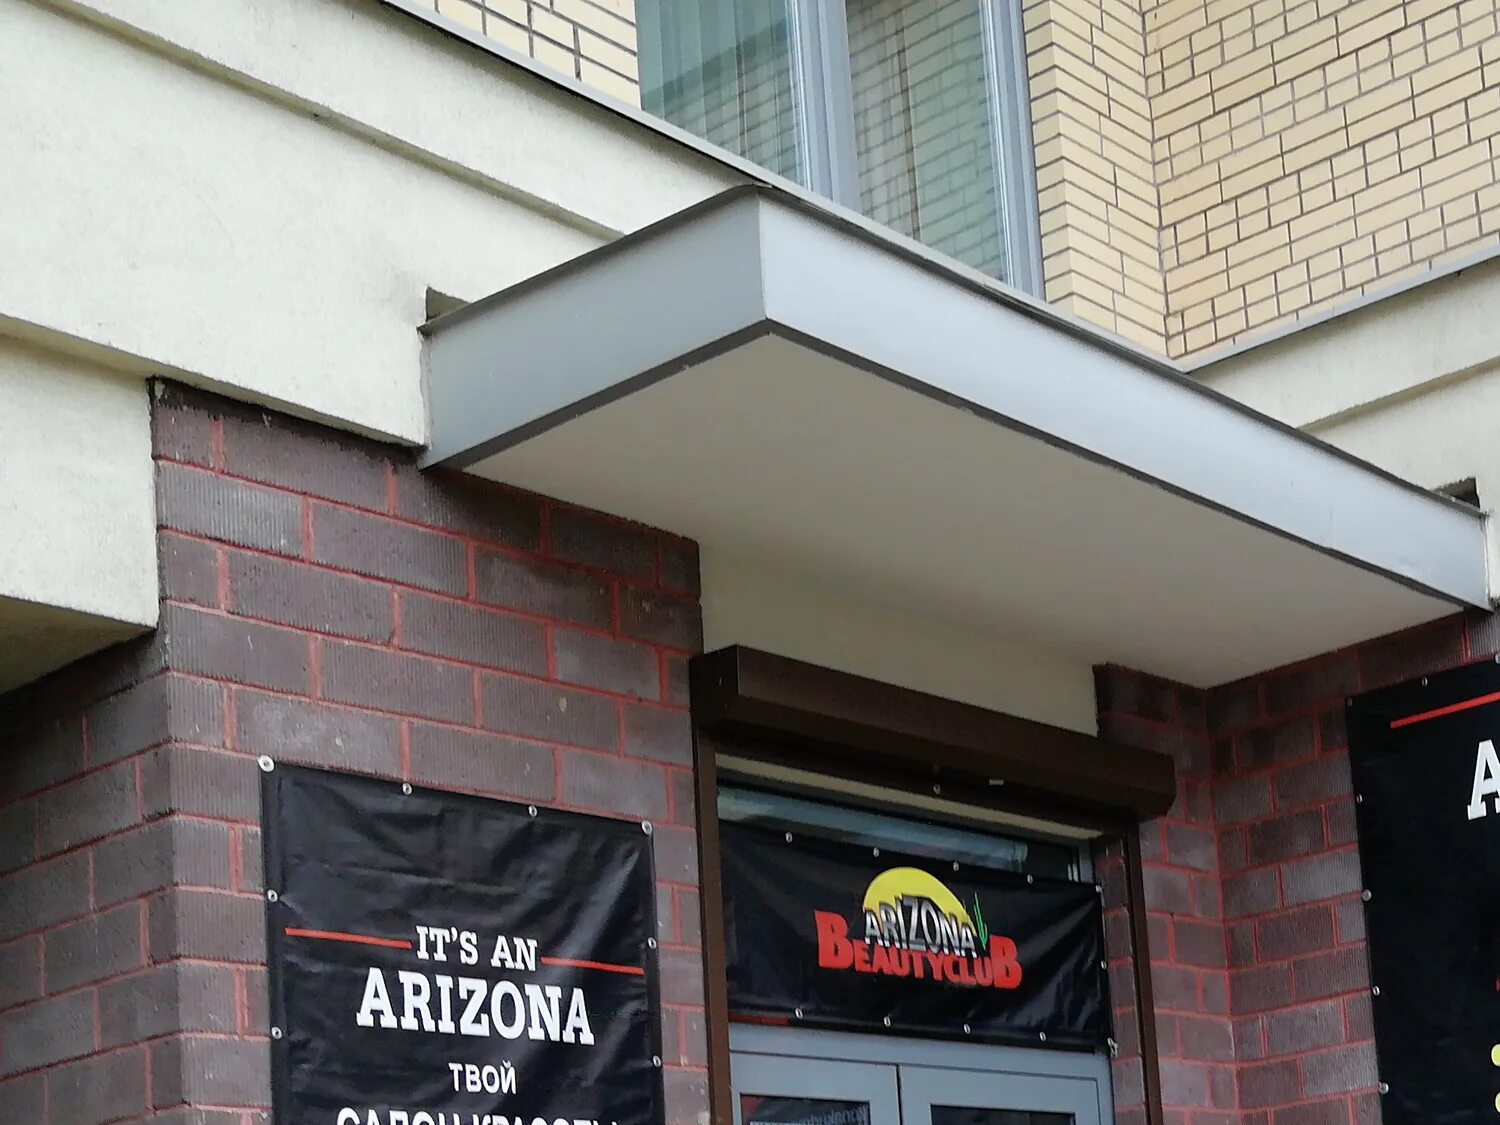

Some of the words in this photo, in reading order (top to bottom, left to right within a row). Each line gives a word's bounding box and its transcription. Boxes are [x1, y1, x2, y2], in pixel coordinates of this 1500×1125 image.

[415, 925, 479, 965] IT'S
[490, 935, 538, 972] AN
[864, 894, 978, 958] ARIZONA
[356, 966, 595, 1045] ARIZONA
